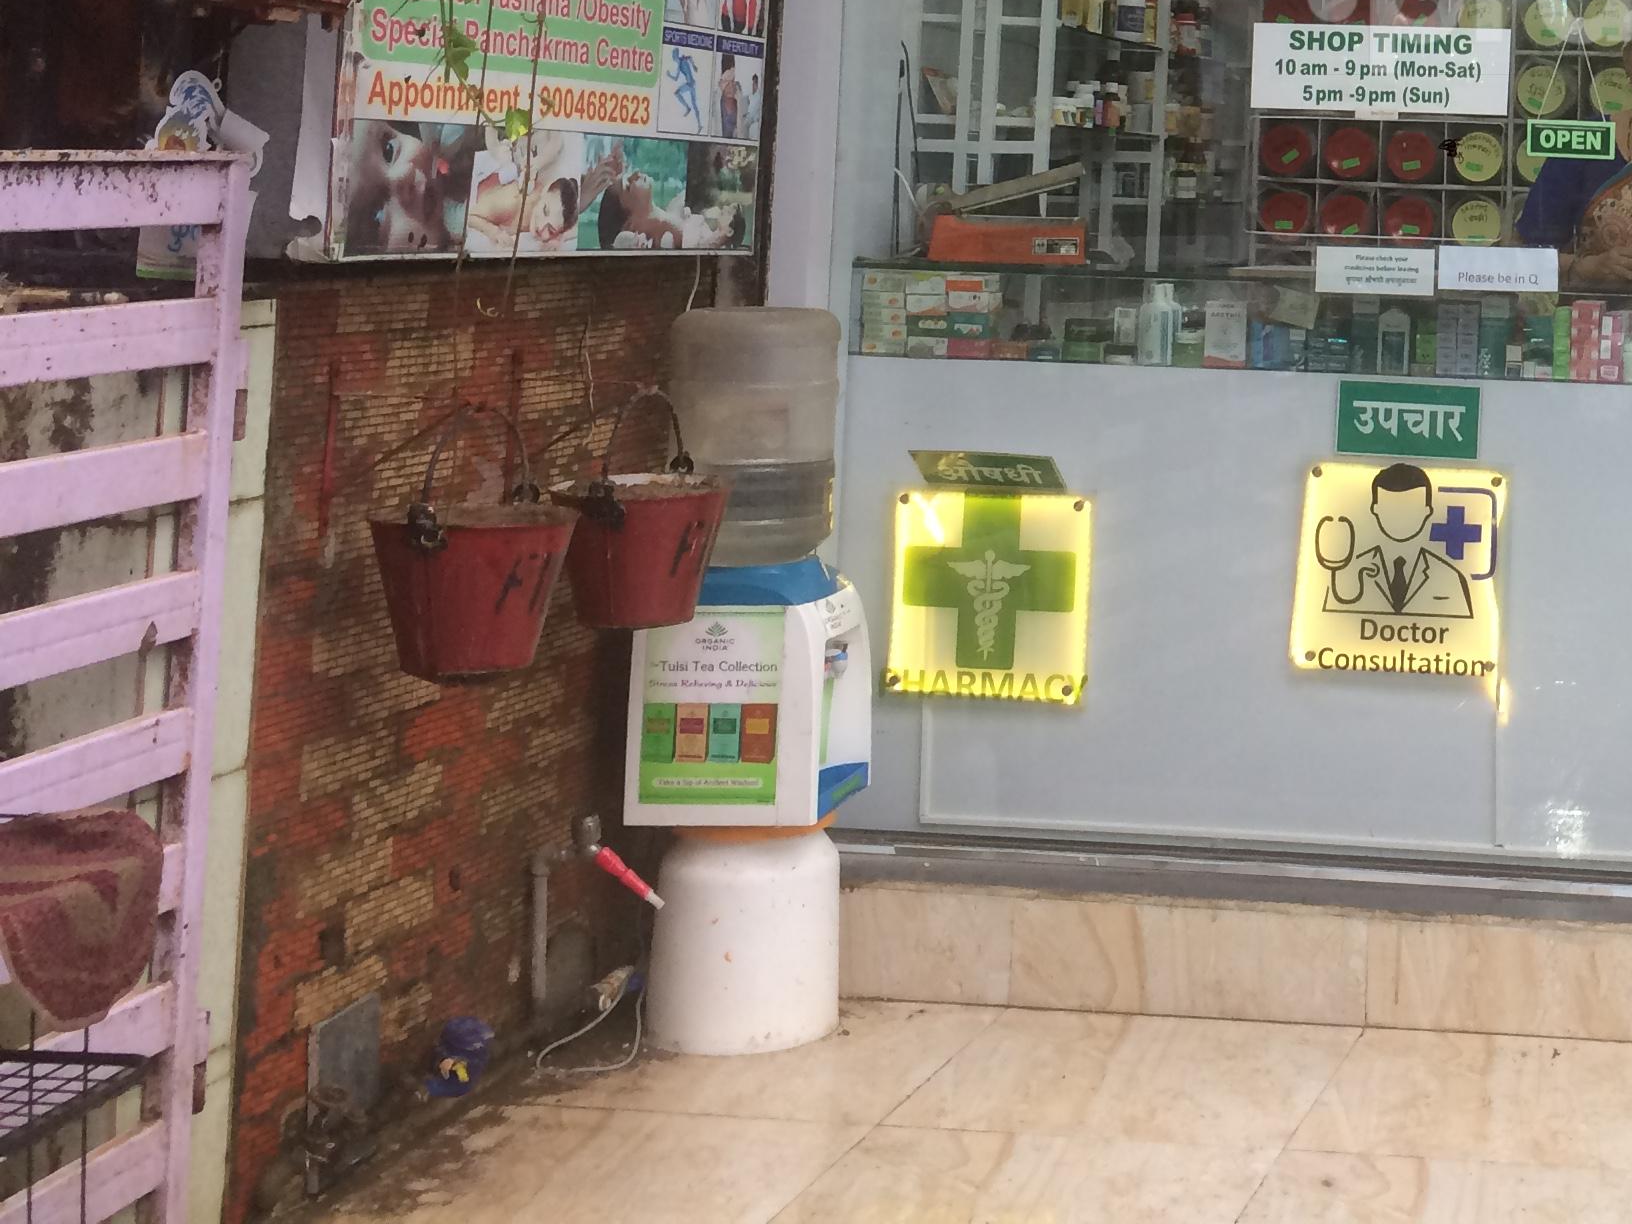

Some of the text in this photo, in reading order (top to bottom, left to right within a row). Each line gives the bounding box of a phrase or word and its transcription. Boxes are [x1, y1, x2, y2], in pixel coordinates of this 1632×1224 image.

[1288, 30, 1473, 55] SHOP TIMING
[596, 38, 654, 73] Centre
[1393, 60, 1482, 83] (Mon-Sat)
[539, 86, 651, 125] 9004682623
[1402, 86, 1450, 107] (Sun)
[1539, 129, 1603, 151] OPEN
[1457, 271, 1539, 286] Please be in Q
[1353, 400, 1467, 442] उपचार
[1359, 618, 1450, 644] Doctor
[660, 660, 689, 672] Tulsi
[692, 660, 715, 672] Tea
[719, 660, 778, 673] Collection
[1317, 647, 1487, 677] Consultation
